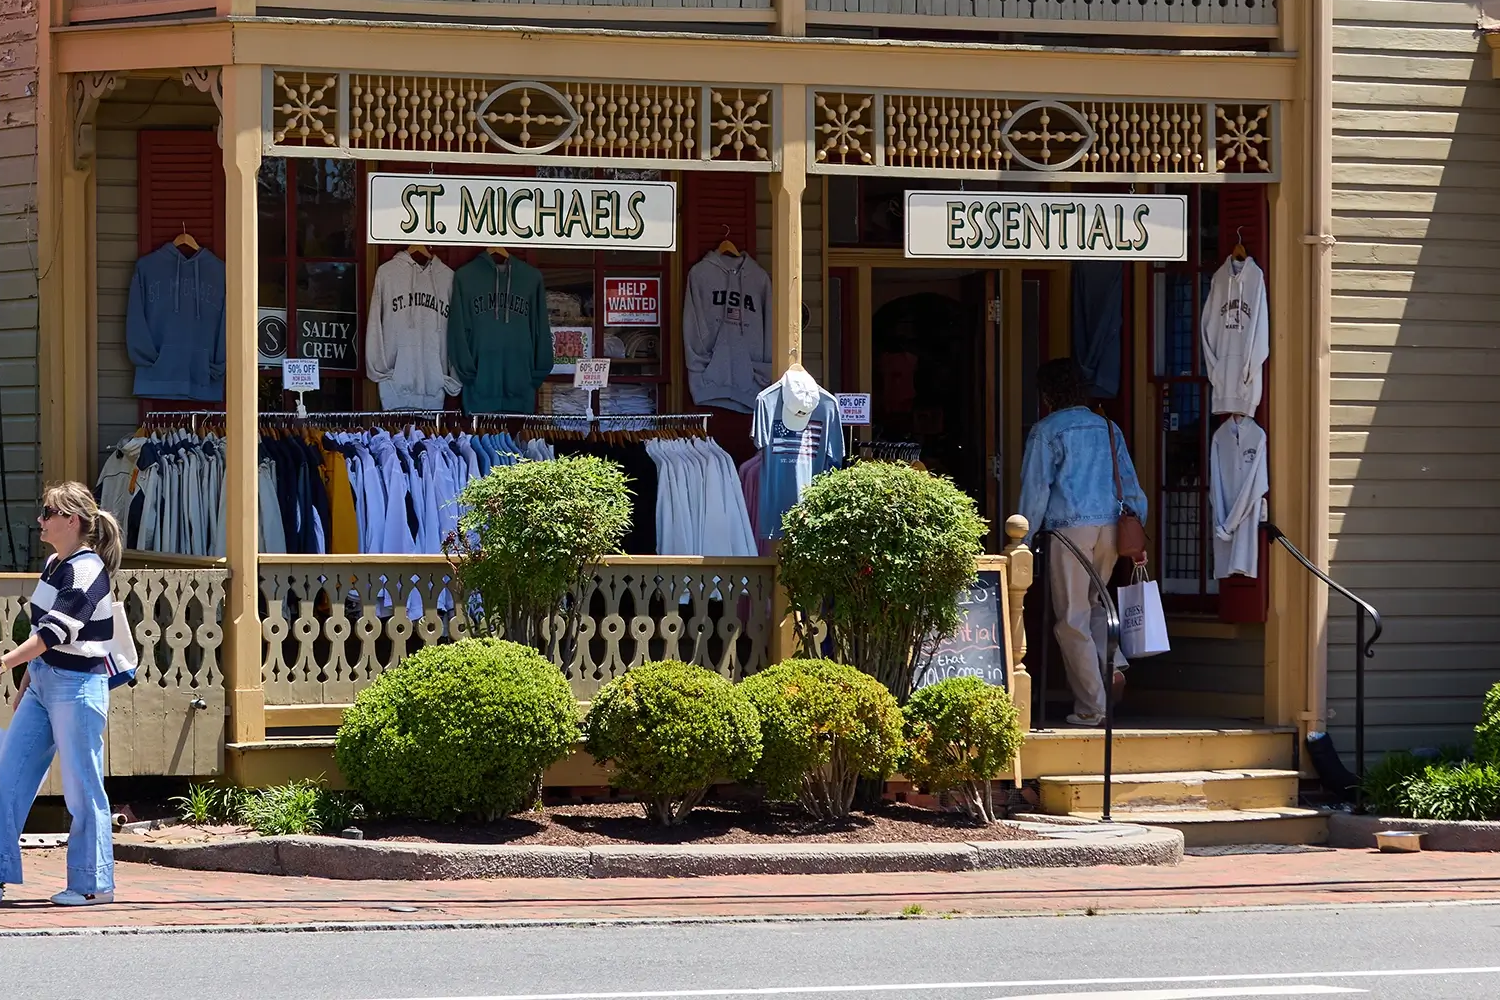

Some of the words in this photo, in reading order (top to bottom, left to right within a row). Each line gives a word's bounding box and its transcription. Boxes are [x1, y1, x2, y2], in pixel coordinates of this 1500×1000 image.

[400, 184, 446, 234] ST.
[458, 186, 646, 239] MICHAELS
[946, 200, 1150, 251] ESSENTIALS
[618, 282, 647, 296] HELP
[392, 295, 406, 313] ST.
[608, 298, 656, 311] WANTED
[712, 290, 756, 312] USA
[302, 320, 350, 339] SALTY
[302, 341, 347, 360] CREW
[288, 364, 302, 374] 50%
[304, 364, 316, 374] OFF
[580, 363, 592, 372] 60%
[594, 363, 606, 372] OFF
[840, 398, 852, 406] 60%
[854, 398, 866, 406] OFF
[938, 654, 966, 666] that
[988, 665, 1003, 680] in
